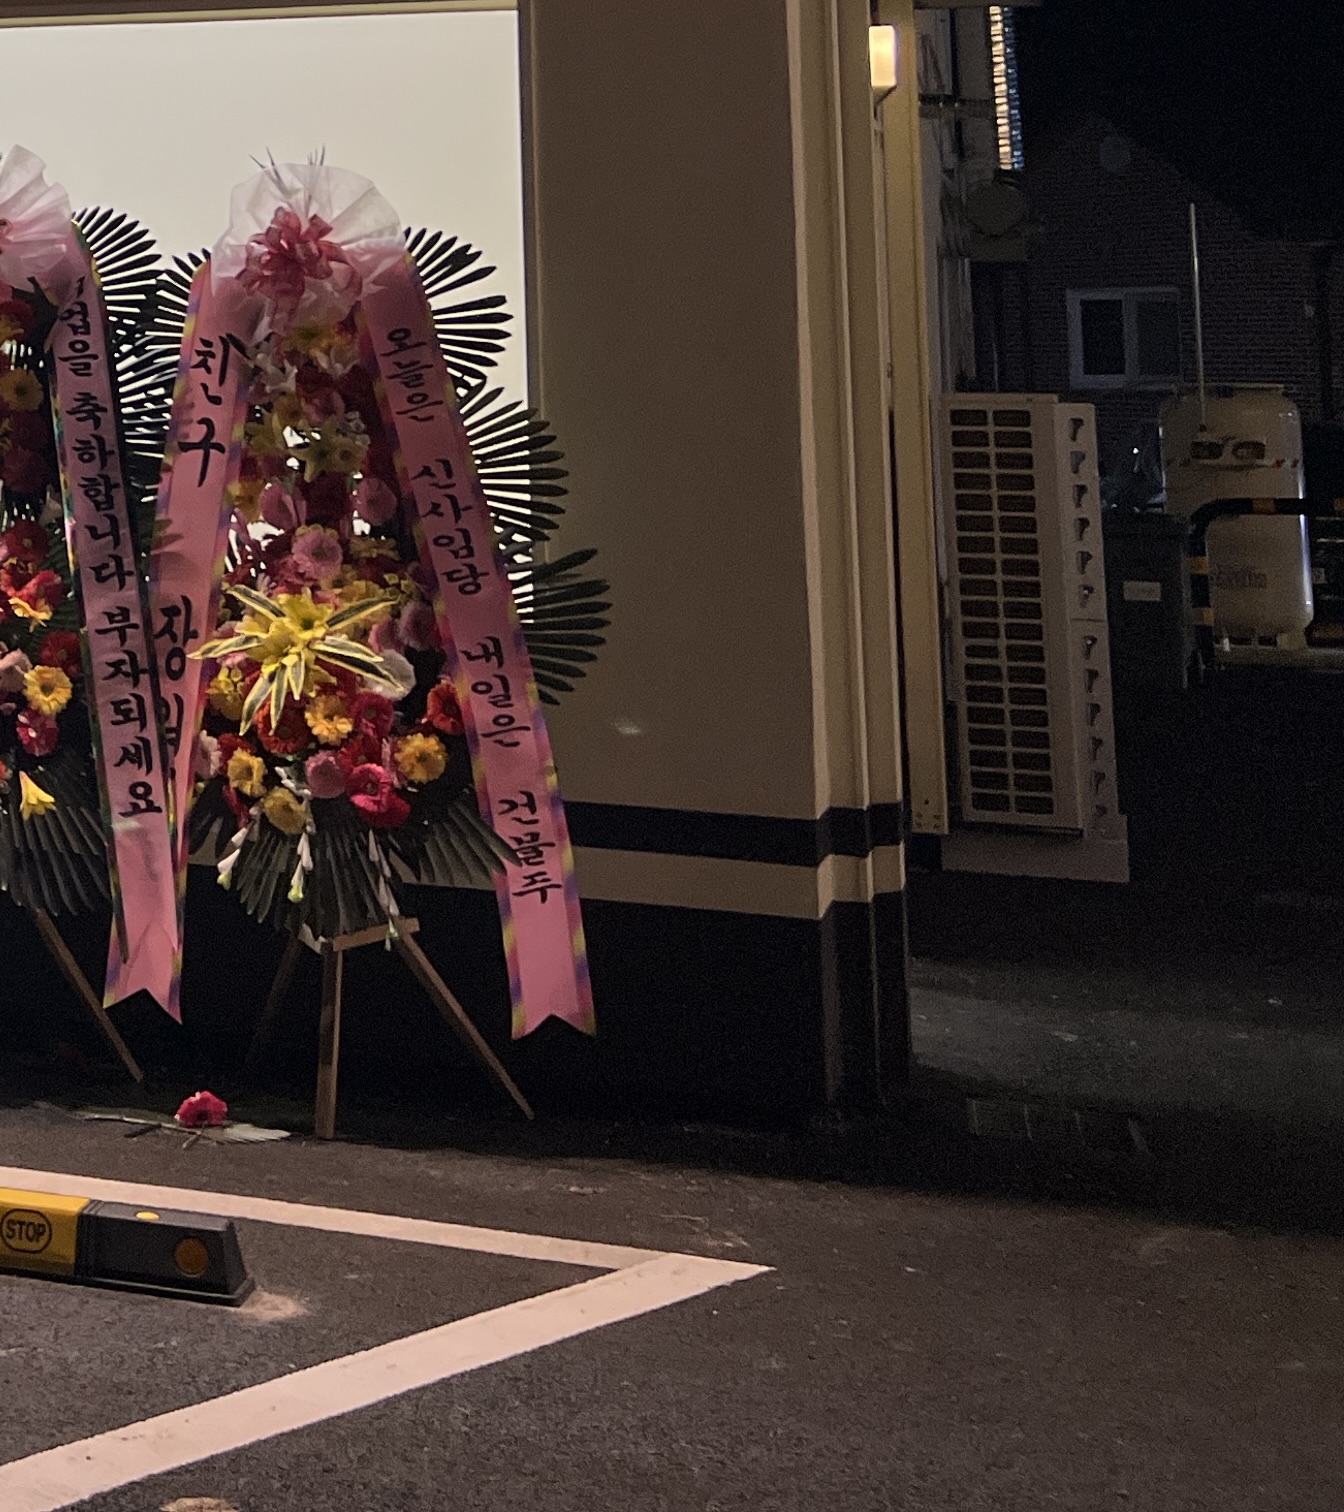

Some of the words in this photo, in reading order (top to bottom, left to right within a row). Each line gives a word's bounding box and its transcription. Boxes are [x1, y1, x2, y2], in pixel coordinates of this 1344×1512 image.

[179, 333, 232, 487] 친구
[379, 326, 443, 422] 오늘은
[65, 387, 133, 592] 축하합니다
[410, 456, 492, 598] 신사임당
[95, 608, 163, 820] 부자되세요
[461, 635, 531, 750] 내일은
[496, 789, 563, 904] 건물주
[4, 1215, 47, 1244] STOP
